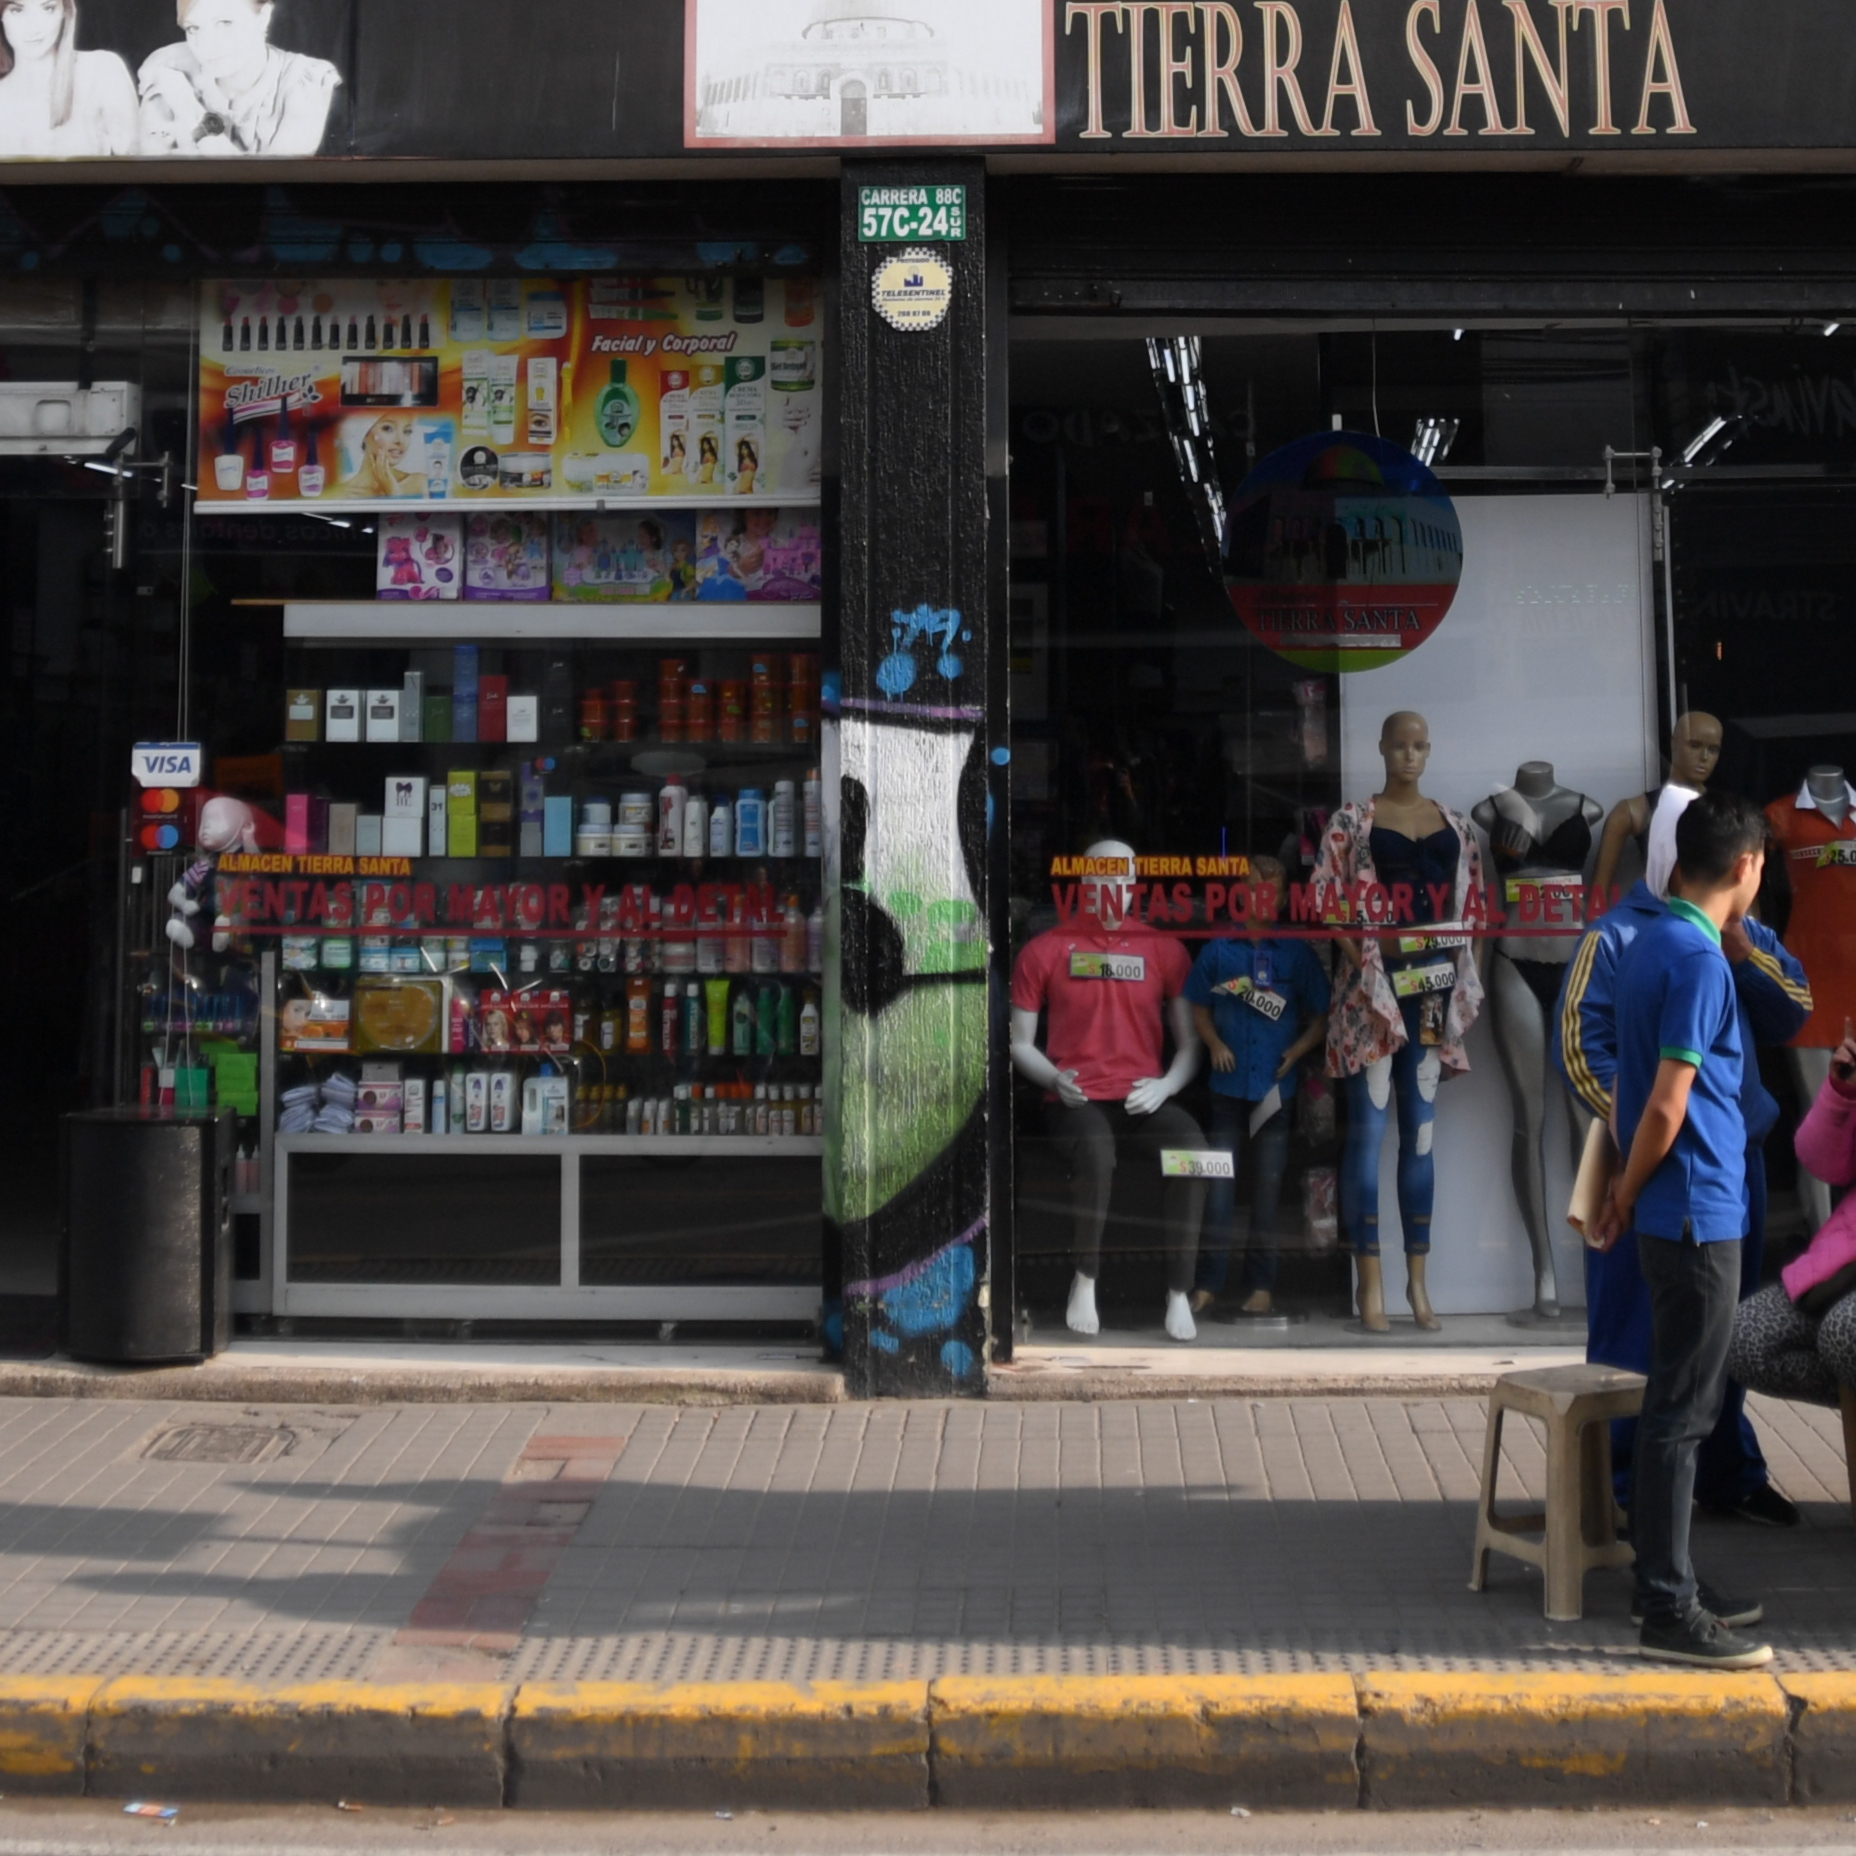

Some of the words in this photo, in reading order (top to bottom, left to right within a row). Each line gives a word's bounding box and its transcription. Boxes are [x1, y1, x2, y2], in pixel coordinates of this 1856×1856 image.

[861, 188, 928, 206] CARRERA
[935, 188, 962, 205] 88C
[862, 206, 949, 237] 57C-24
[591, 334, 641, 352] Facial
[662, 331, 737, 357] Corporal
[1343, 608, 1422, 632] SANTA
[144, 756, 192, 774] VISA
[217, 854, 293, 874] ALMACEN
[298, 855, 356, 875] TIERRA
[359, 856, 412, 877] SANTA
[1050, 855, 1130, 877] ALMACEN
[1133, 855, 1194, 877] TIERRA
[1196, 855, 1251, 877] SANTA
[216, 880, 353, 922] VENTAS
[365, 881, 437, 923] POR
[447, 882, 572, 924] MAYOR
[582, 883, 608, 924] Y
[618, 883, 663, 924] AL
[673, 883, 786, 924] DETAL
[1051, 881, 1193, 924] VENTAS
[1205, 881, 1279, 924] POR
[1289, 882, 1415, 923] MAYOR
[1426, 883, 1451, 923] Y
[1462, 883, 1508, 924] AL
